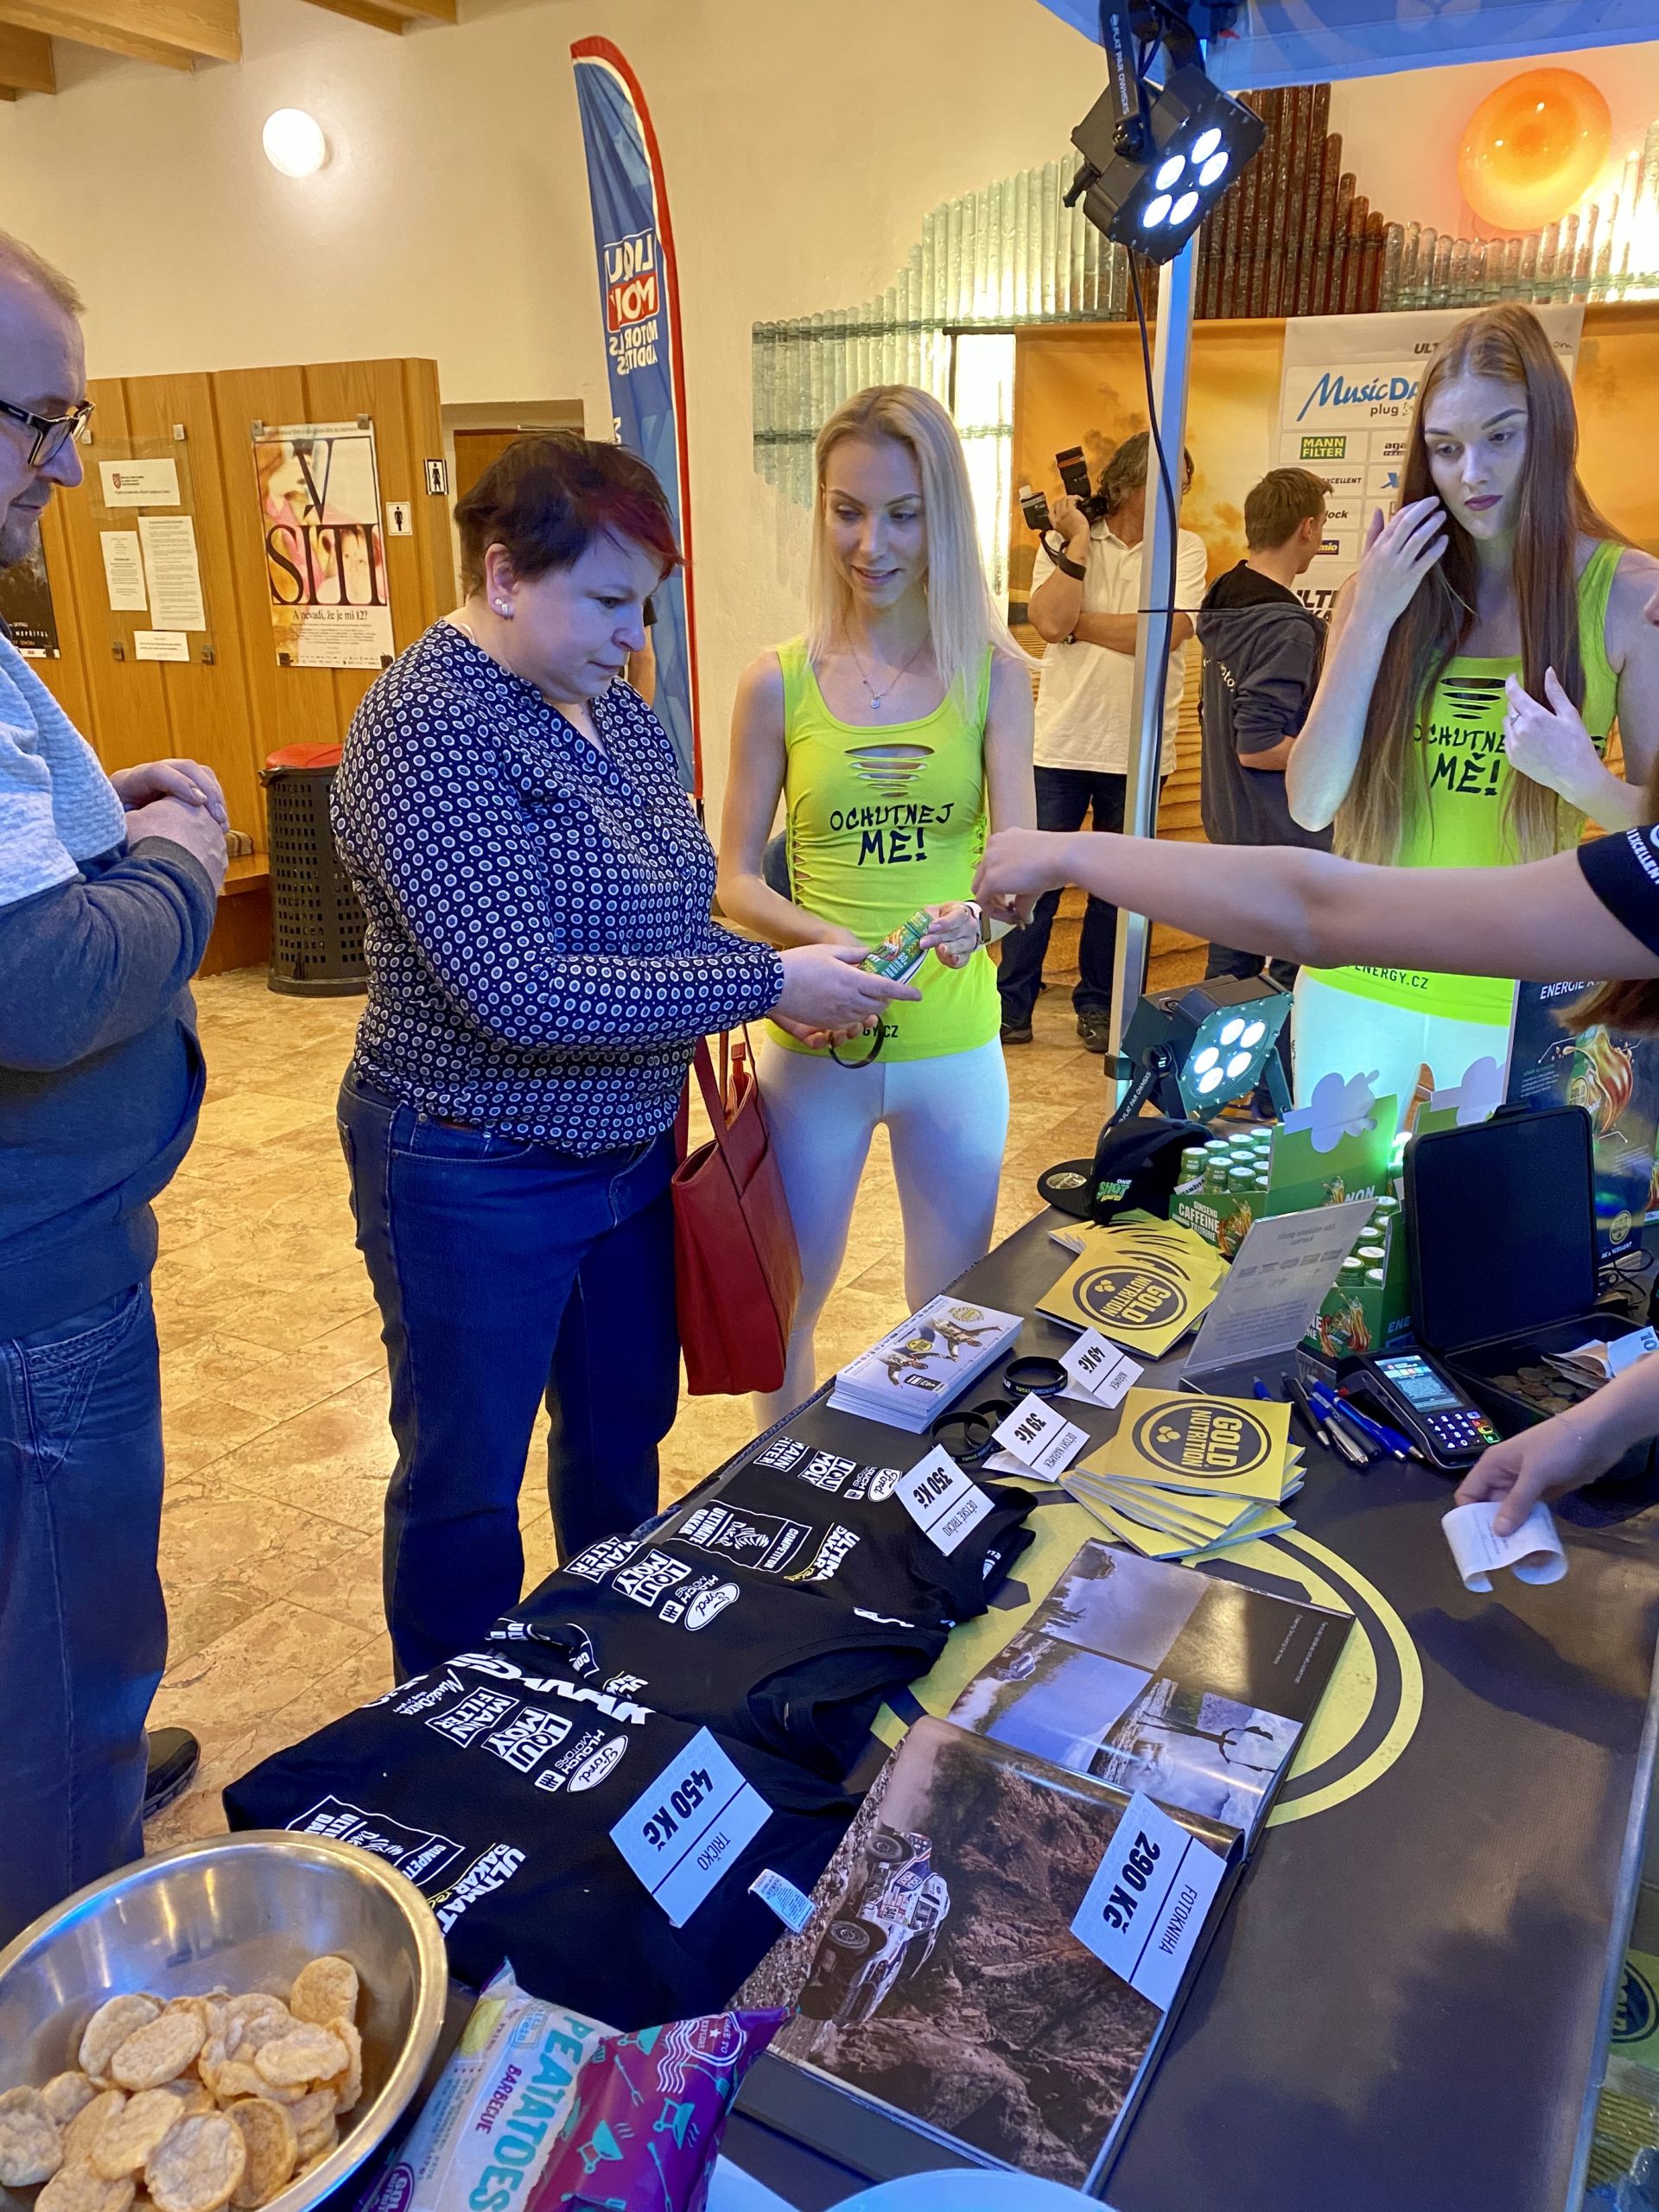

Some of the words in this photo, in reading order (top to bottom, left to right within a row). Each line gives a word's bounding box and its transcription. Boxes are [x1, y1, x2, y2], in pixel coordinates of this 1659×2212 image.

[1370, 404, 1399, 417] plug
[1302, 448, 1343, 458] FILTER
[1303, 438, 1344, 448] MANN
[290, 439, 334, 524] V
[292, 609, 300, 620] A
[327, 609, 335, 620] že
[335, 609, 344, 622] je
[344, 609, 355, 620] mi
[1413, 722, 1508, 754] OCHUTNE
[1430, 752, 1501, 797] MĚ!
[830, 802, 955, 832] OCHUTNEJ
[857, 825, 928, 867] MĚ!
[1122, 1106, 1135, 1122] FLAT
[1130, 1092, 1141, 1107] PAR
[1096, 1181, 1130, 1200] SHOT
[1193, 1200, 1218, 1219] GINSENG
[1178, 1202, 1220, 1234] CAFFEINE
[1190, 1221, 1217, 1243] TAURINE
[1099, 1274, 1154, 1319] NUTRITION
[1121, 1284, 1173, 1324] GOLD
[1077, 1351, 1096, 1374] Kč
[1087, 1345, 1106, 1363] 49
[1014, 1421, 1037, 1445] Kč
[1028, 1412, 1047, 1433] 39
[1180, 1408, 1213, 1469] NUTRITION
[1205, 1415, 1243, 1468] GOLD
[775, 1440, 806, 1471] MANN
[801, 1451, 831, 1486] MOLY
[819, 1457, 855, 1491] LIQUI
[1043, 1446, 1066, 1469] NÁRAMEK
[877, 1469, 900, 1496] Ford
[912, 1483, 936, 1510] Kč
[929, 1465, 954, 1497] 350
[690, 1506, 728, 1545] ULTIMATE
[941, 1514, 962, 1536] TRIČKO
[960, 1499, 978, 1522] DĚTSKÉ
[764, 1526, 799, 1570] COMPETITOR
[812, 1523, 849, 1570] DAKAR
[617, 1552, 664, 1592] MOLY
[639, 1558, 690, 1605] LIQUI
[398, 1668, 465, 1716] MusicDATA
[435, 1690, 493, 1731] FILTER
[450, 1697, 512, 1747] MANN
[514, 1715, 569, 1770] LIQUI
[554, 1731, 592, 1770] MOTORS
[562, 1729, 606, 1775] HLOUCH
[578, 1745, 619, 1783] Ford
[670, 1768, 715, 1820] 450
[642, 1805, 680, 1853] Kč
[402, 1843, 448, 1881] COMPETI
[451, 1843, 511, 1894] DAKAR
[696, 1831, 732, 1872] TRIČKO
[1121, 1830, 1161, 1892] 290
[437, 1847, 527, 1938] ULTIMAT
[1103, 1884, 1139, 1935] Kč
[1158, 1884, 1198, 1956] FOTOKNIHA
[467, 2014, 596, 2212] PEATATOES
[474, 2063, 524, 2136] BARBECUE
